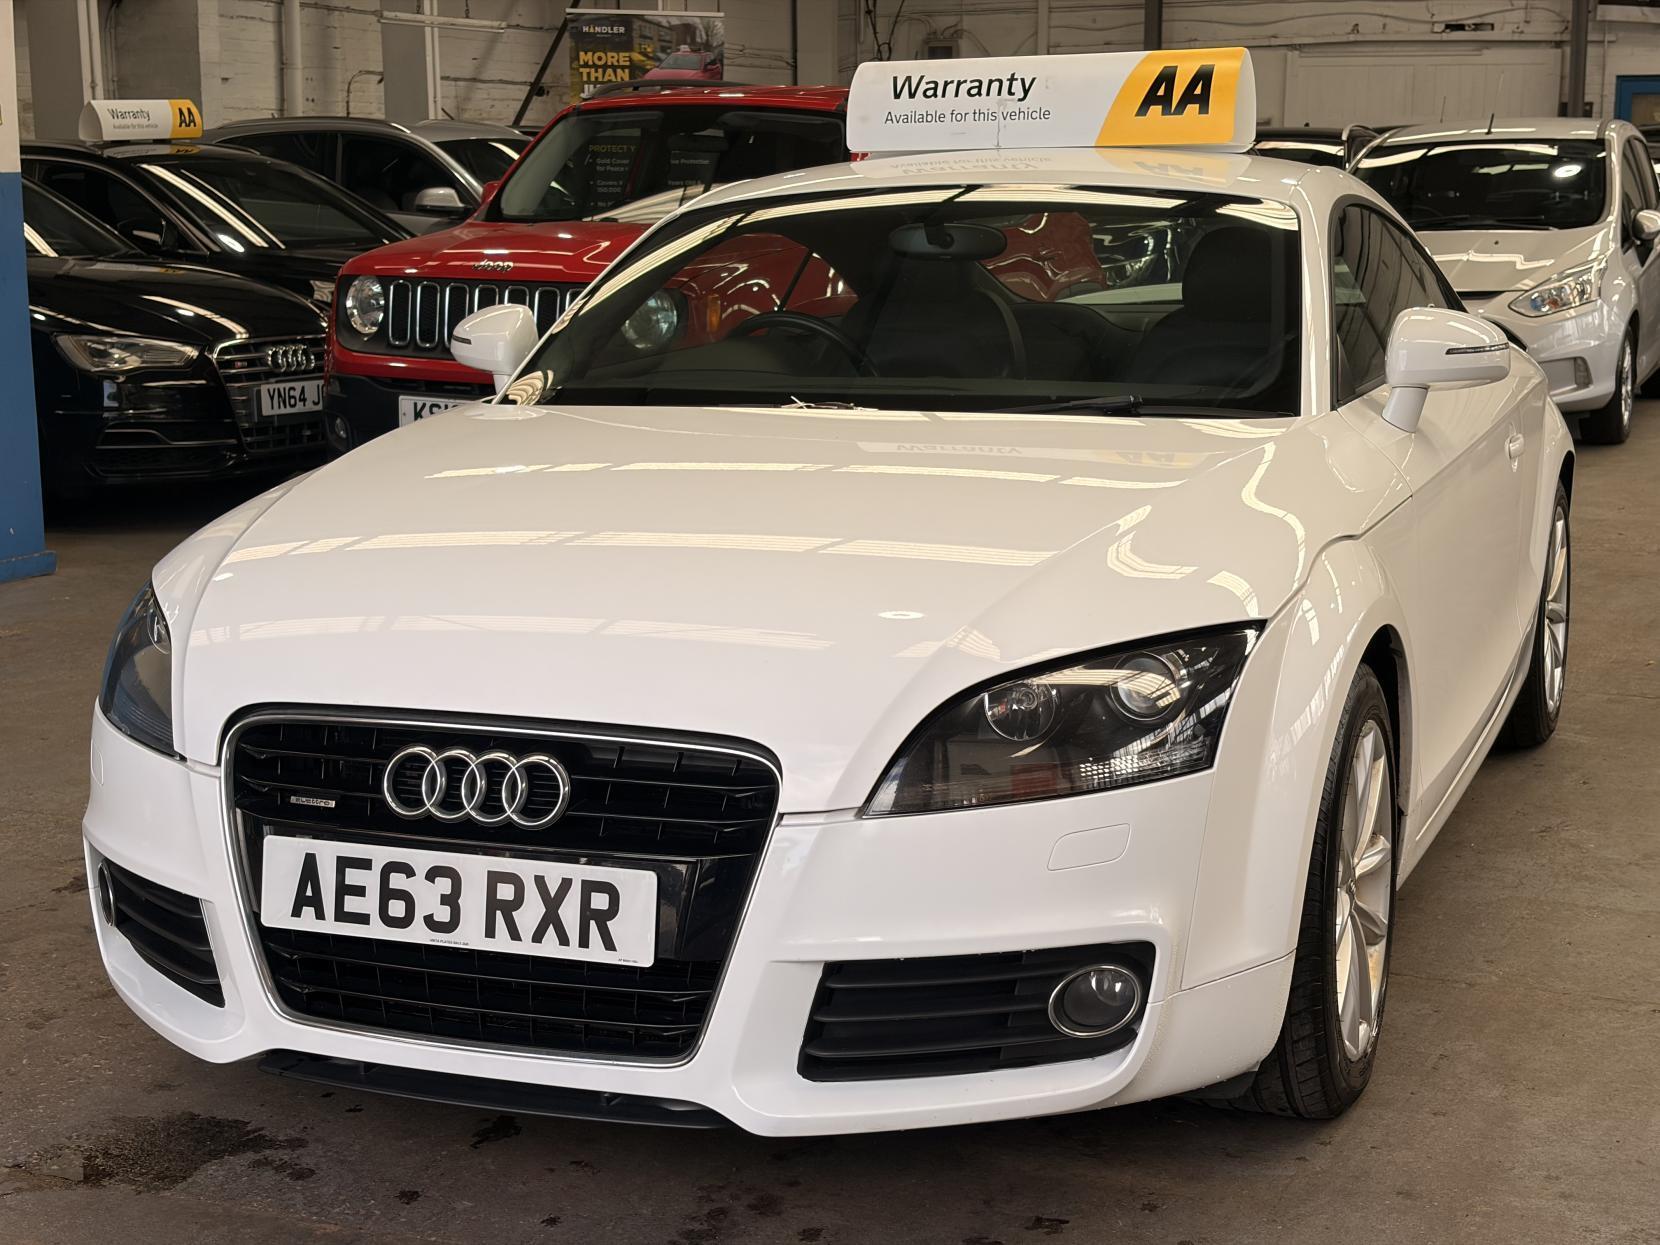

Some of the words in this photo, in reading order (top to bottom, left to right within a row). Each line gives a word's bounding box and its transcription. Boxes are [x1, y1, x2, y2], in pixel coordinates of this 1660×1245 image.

[578, 51, 631, 66] MORE
[579, 67, 630, 82] THAN
[892, 72, 1037, 102] Warranty
[1134, 64, 1216, 117] AA
[107, 108, 150, 121] Warranty
[178, 107, 197, 128] AA
[885, 110, 946, 124] Available
[950, 109, 969, 123] for
[972, 108, 997, 122] this
[1001, 107, 1051, 121] vehicle
[267, 385, 307, 410] YN64
[290, 852, 462, 934] AE63
[484, 869, 621, 952] RXR
